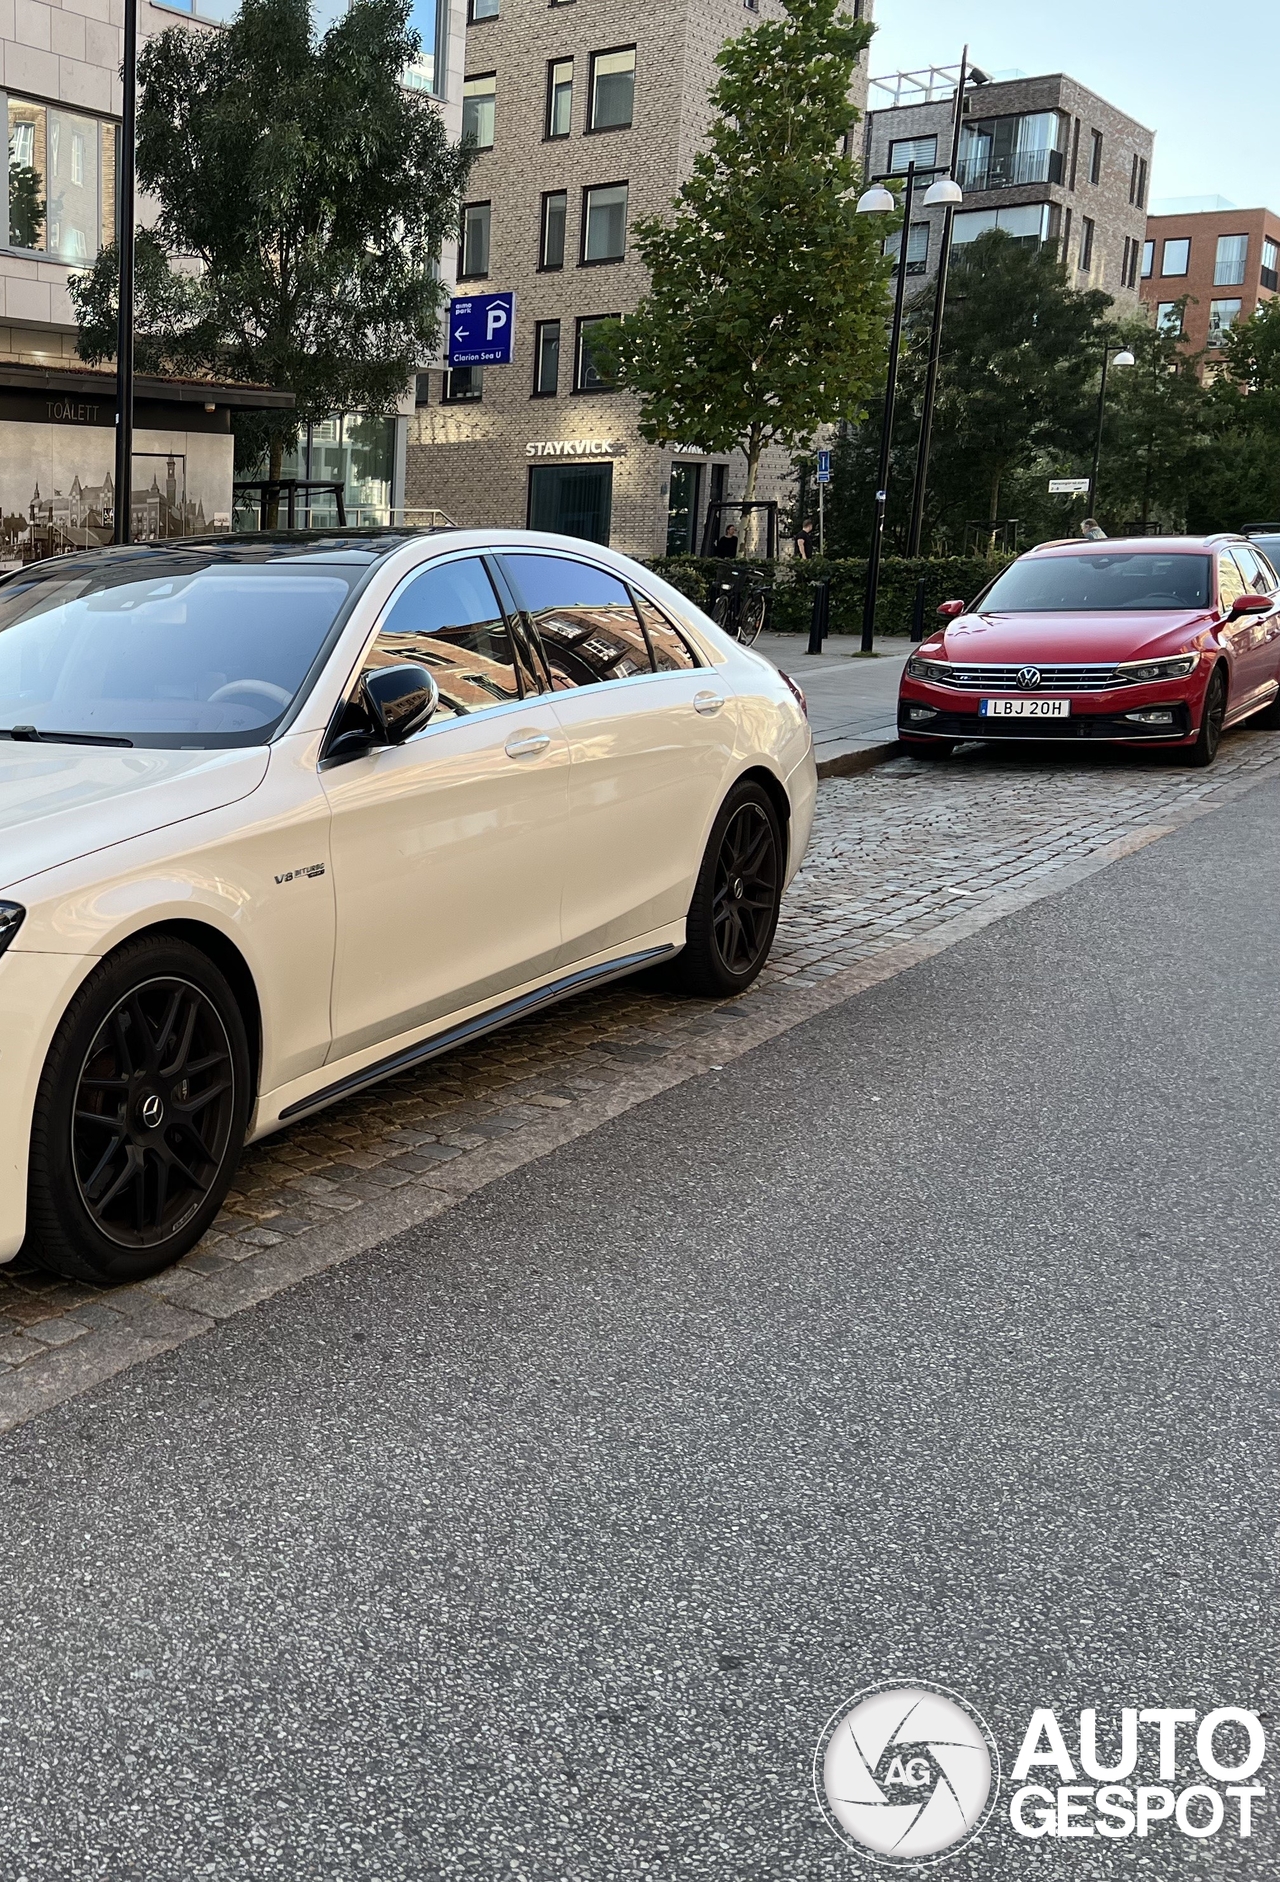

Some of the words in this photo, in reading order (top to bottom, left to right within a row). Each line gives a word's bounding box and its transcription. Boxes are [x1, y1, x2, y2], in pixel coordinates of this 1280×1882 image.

[455, 308, 472, 316] park
[486, 309, 507, 341] P
[453, 353, 479, 362] Clarion
[480, 352, 494, 360] Sea
[495, 351, 502, 359] U
[46, 401, 99, 421] TOALETT
[525, 439, 613, 457] STAYKVICK
[993, 701, 1024, 715] LBJ
[1029, 701, 1062, 715] 20H
[274, 872, 293, 884] V8
